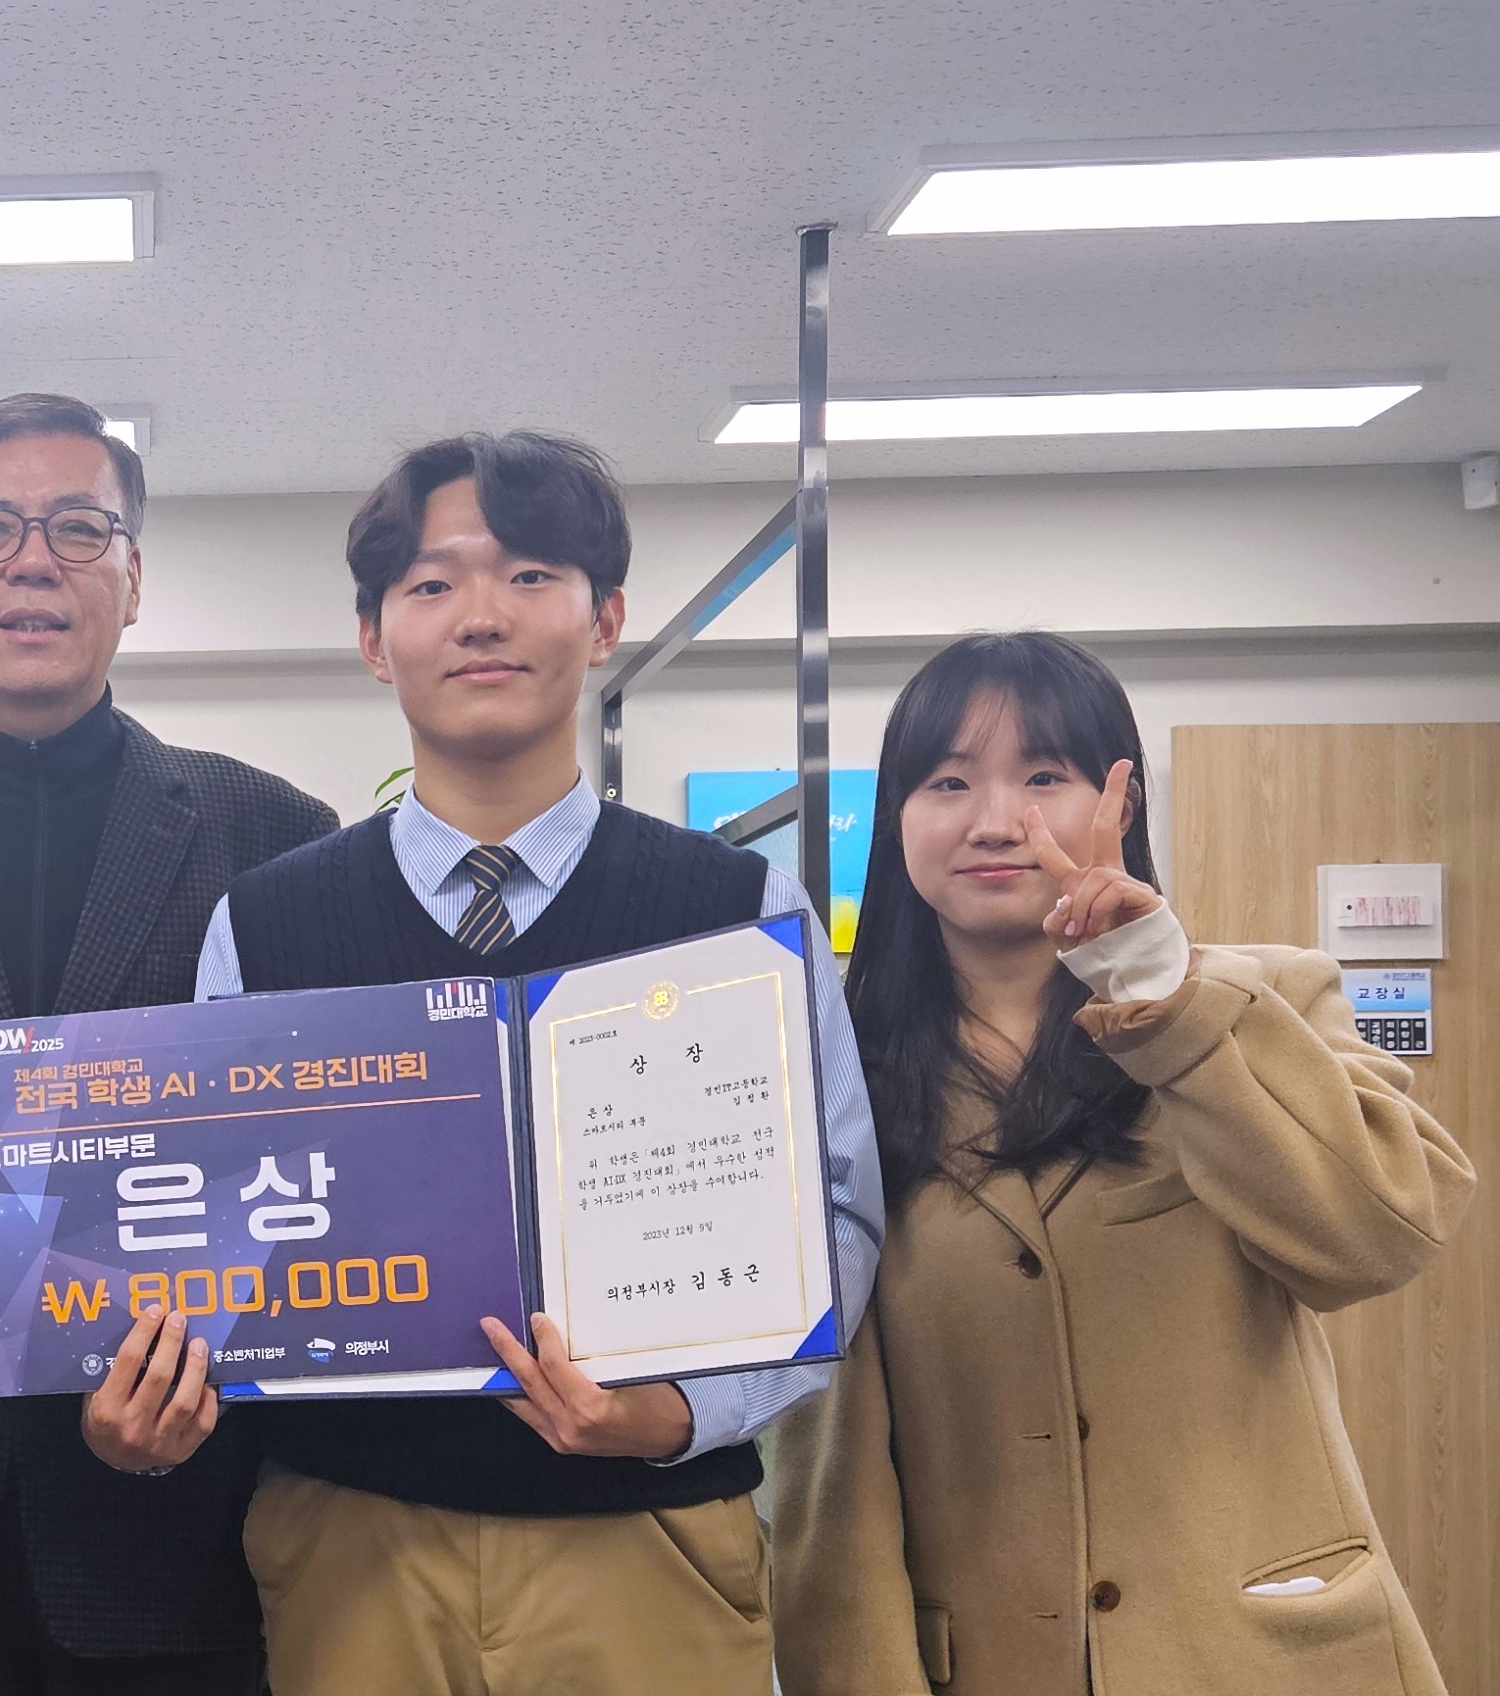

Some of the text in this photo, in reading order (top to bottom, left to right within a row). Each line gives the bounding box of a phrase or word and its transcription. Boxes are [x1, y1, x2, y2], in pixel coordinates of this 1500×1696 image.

[427, 1006, 488, 1022] 경민대학교
[31, 1037, 65, 1053] 2025
[14, 1058, 143, 1083] 제4회 경민대학교
[15, 1081, 79, 1115] 전국
[87, 1075, 152, 1107] 학생
[160, 1071, 196, 1099] AI
[228, 1063, 284, 1093] DX
[292, 1051, 428, 1091] 경진대회
[687, 1133, 741, 1153] 경민대학교
[578, 1178, 596, 1191] 학생
[714, 1151, 746, 1167] 우수한
[667, 1179, 698, 1195] 상장을
[128, 1254, 429, 1320] 800,000
[607, 1278, 676, 1301] 의정부시장
[213, 1346, 286, 1364] 중소벤처기업부
[345, 1338, 390, 1356] 의정부시
